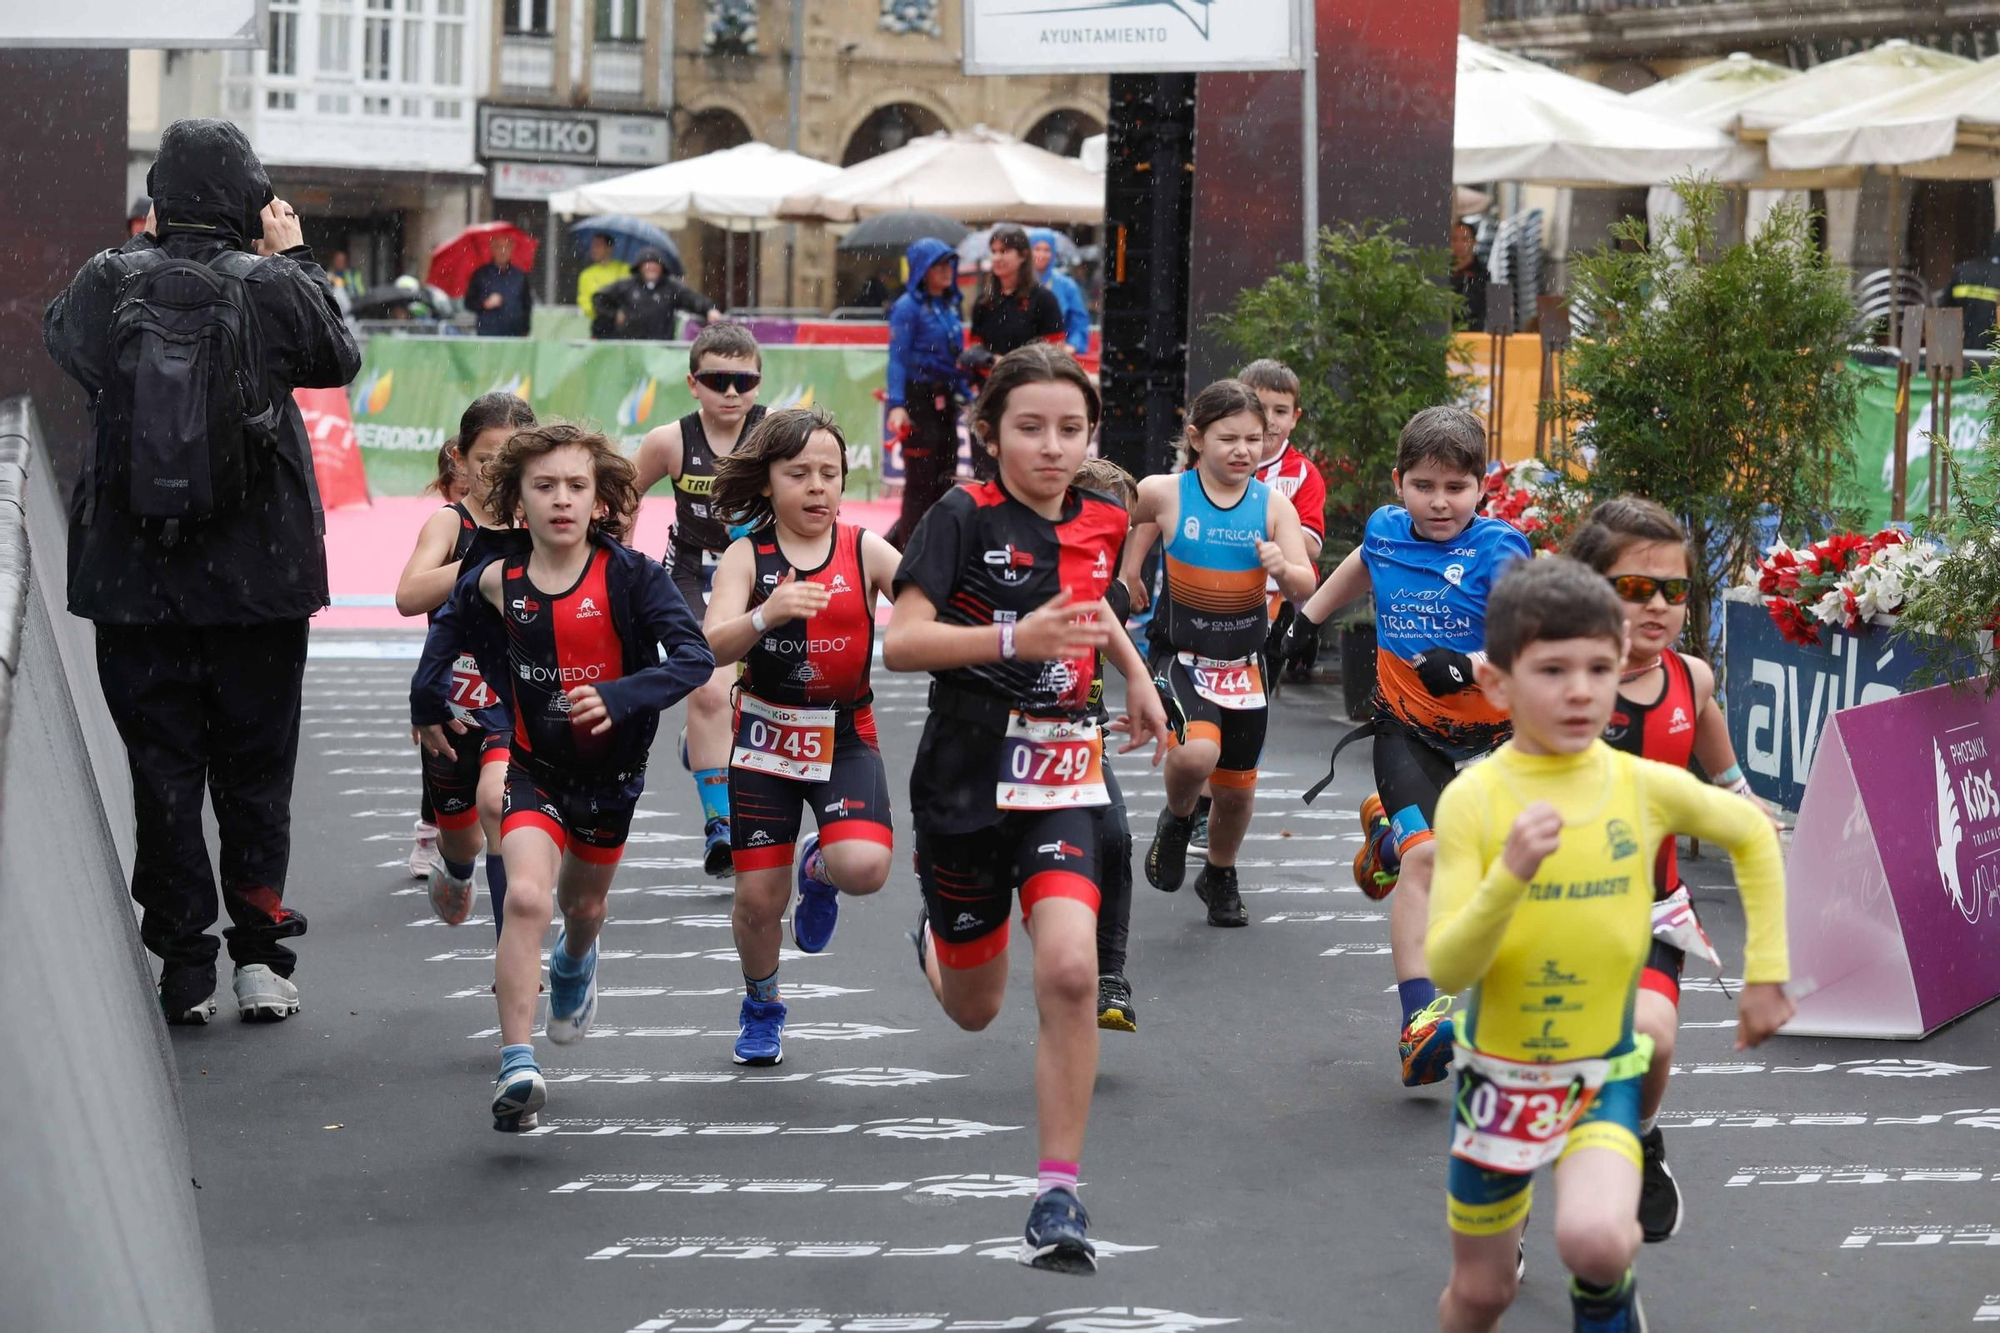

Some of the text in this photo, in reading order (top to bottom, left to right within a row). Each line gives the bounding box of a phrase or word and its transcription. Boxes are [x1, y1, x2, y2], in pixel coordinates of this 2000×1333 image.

[1040, 27, 1168, 44] AYUNTAMIENTO
[488, 116, 596, 154] SEIKO
[687, 479, 713, 492] TRI
[1391, 601, 1453, 614] escuela
[779, 638, 847, 654] OVIEDO
[532, 665, 600, 683] OVIEDO
[1194, 668, 1252, 693] 0744
[750, 719, 822, 758] 0745
[1011, 744, 1090, 782] 0749
